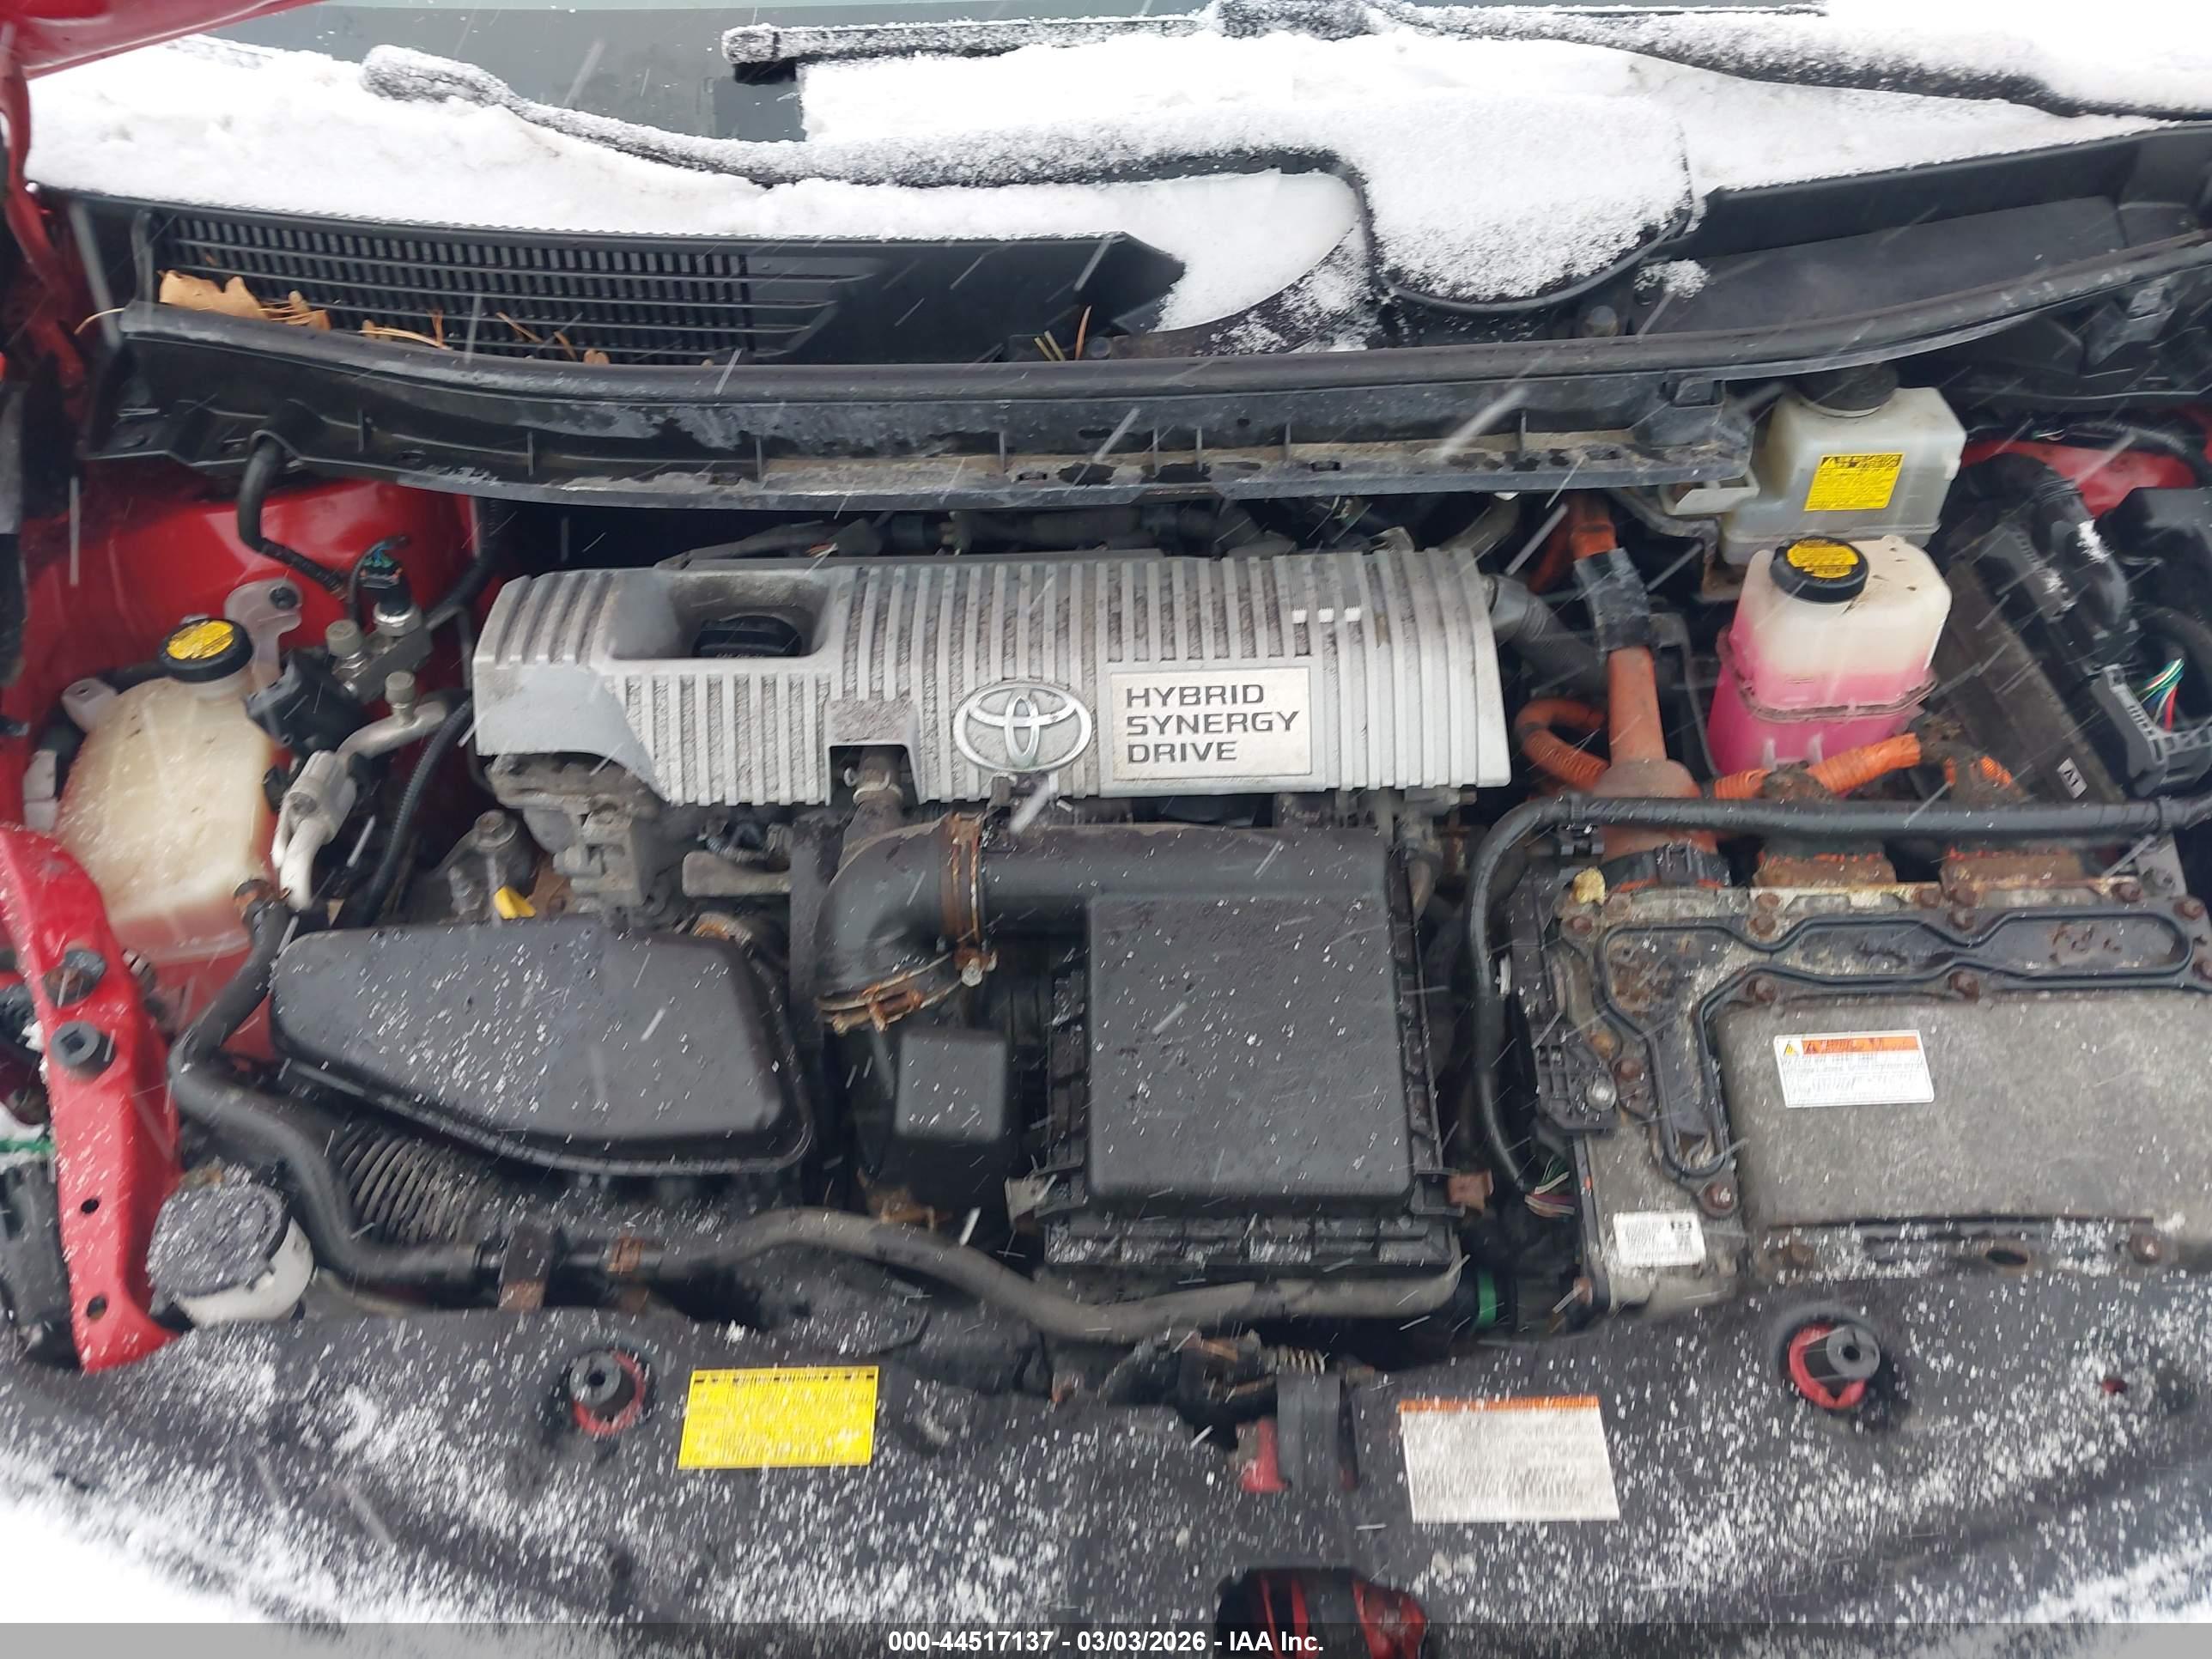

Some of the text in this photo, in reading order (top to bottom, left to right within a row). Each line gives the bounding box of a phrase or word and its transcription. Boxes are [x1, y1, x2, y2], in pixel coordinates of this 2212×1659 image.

[1126, 684, 1264, 708] HYBRID
[1126, 710, 1299, 736] SYNERGY
[1127, 741, 1237, 764] DRIVE
